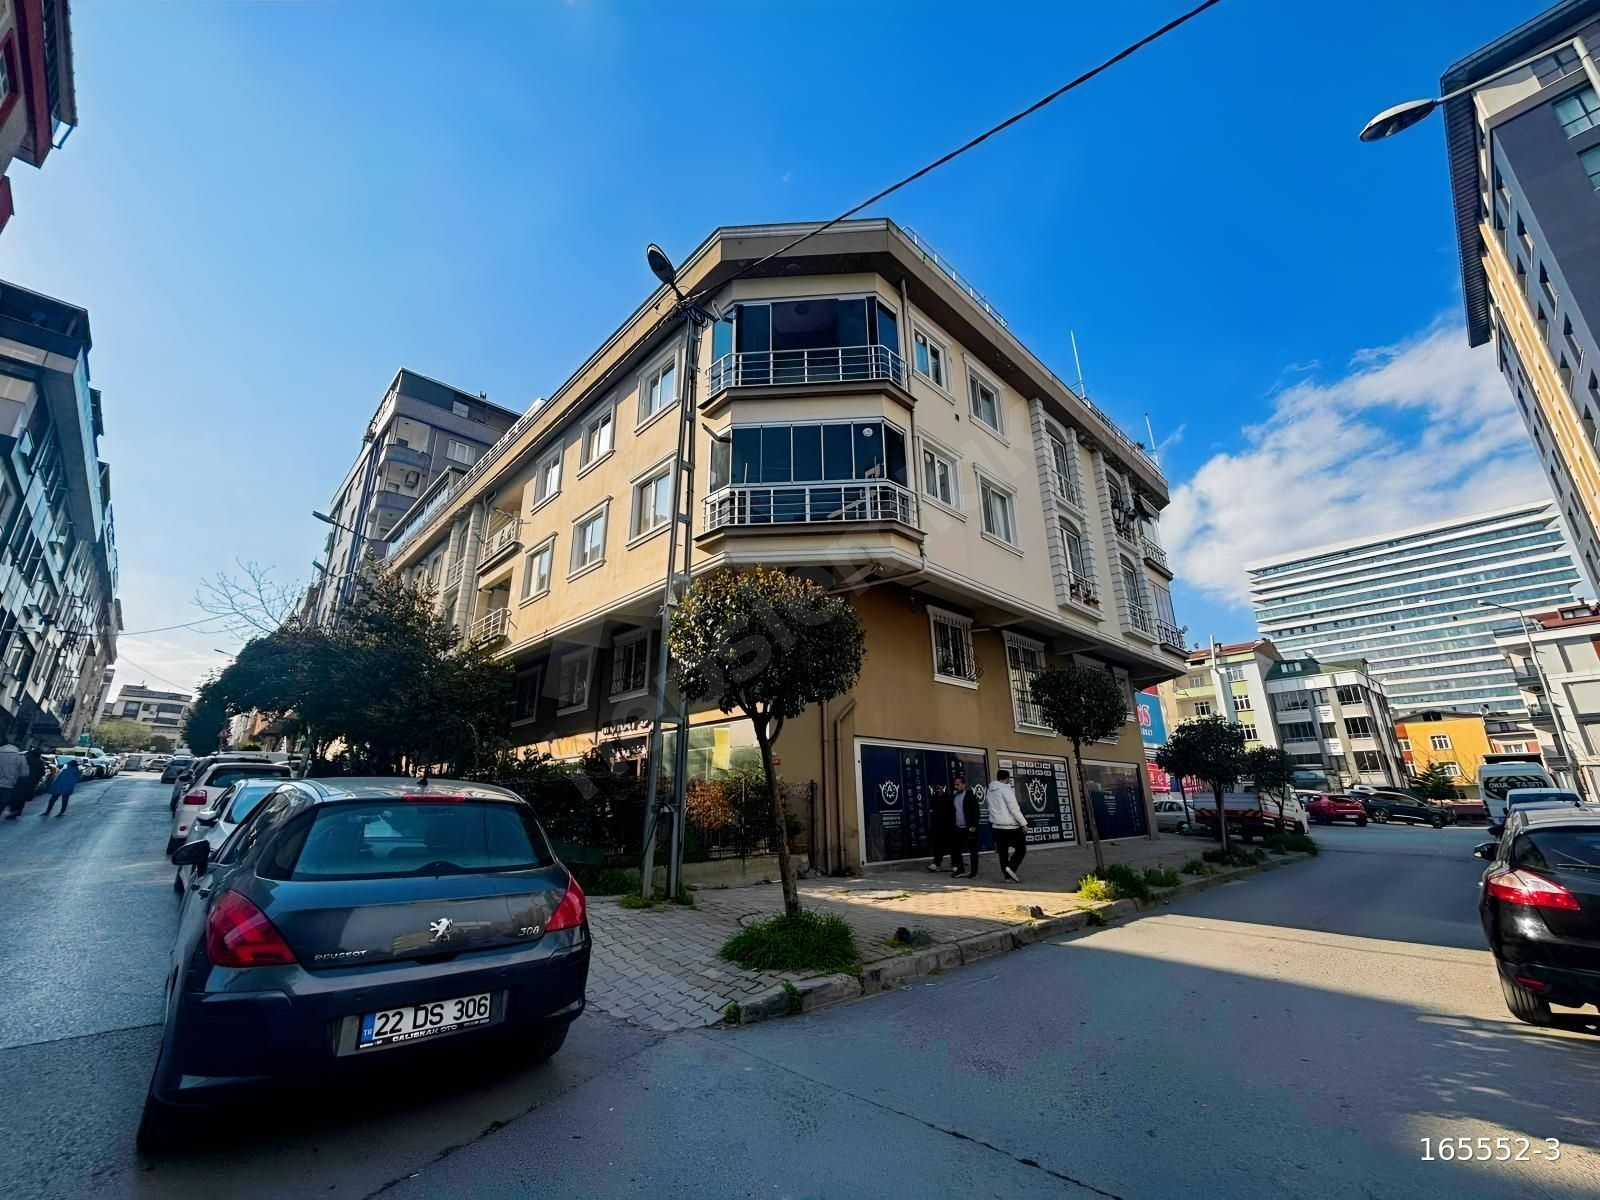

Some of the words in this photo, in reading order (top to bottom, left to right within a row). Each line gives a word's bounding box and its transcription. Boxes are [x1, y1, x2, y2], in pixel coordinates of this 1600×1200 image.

[518, 925, 540, 936] 308
[314, 950, 369, 961] PEUGEOT
[374, 1011, 404, 1038] 22
[412, 1003, 445, 1030] DS
[452, 995, 489, 1021] 306
[440, 1024, 458, 1033] OTO
